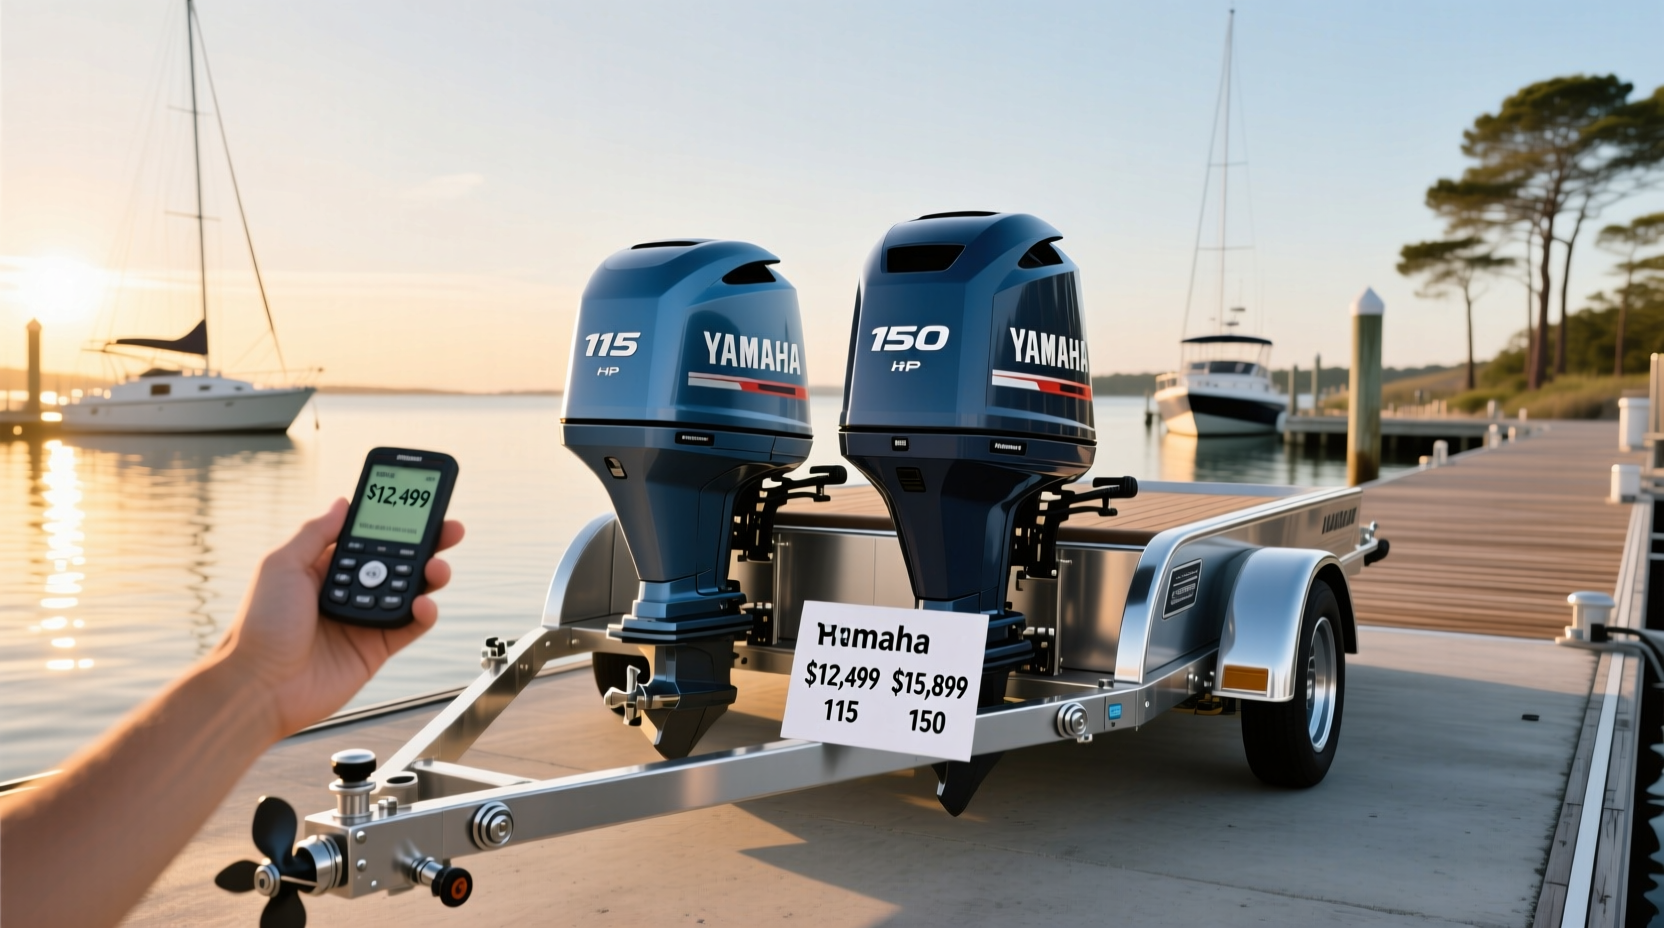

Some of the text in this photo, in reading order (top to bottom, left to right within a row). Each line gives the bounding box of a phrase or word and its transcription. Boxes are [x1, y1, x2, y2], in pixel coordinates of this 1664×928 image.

[584, 331, 642, 358] 115
[871, 324, 950, 352] 150
[703, 330, 801, 376] YAMAHA
[596, 366, 620, 377] HP
[367, 483, 431, 508] $12,499
[804, 659, 969, 700] $12,499 $15,899
[824, 698, 946, 734] 115 150
